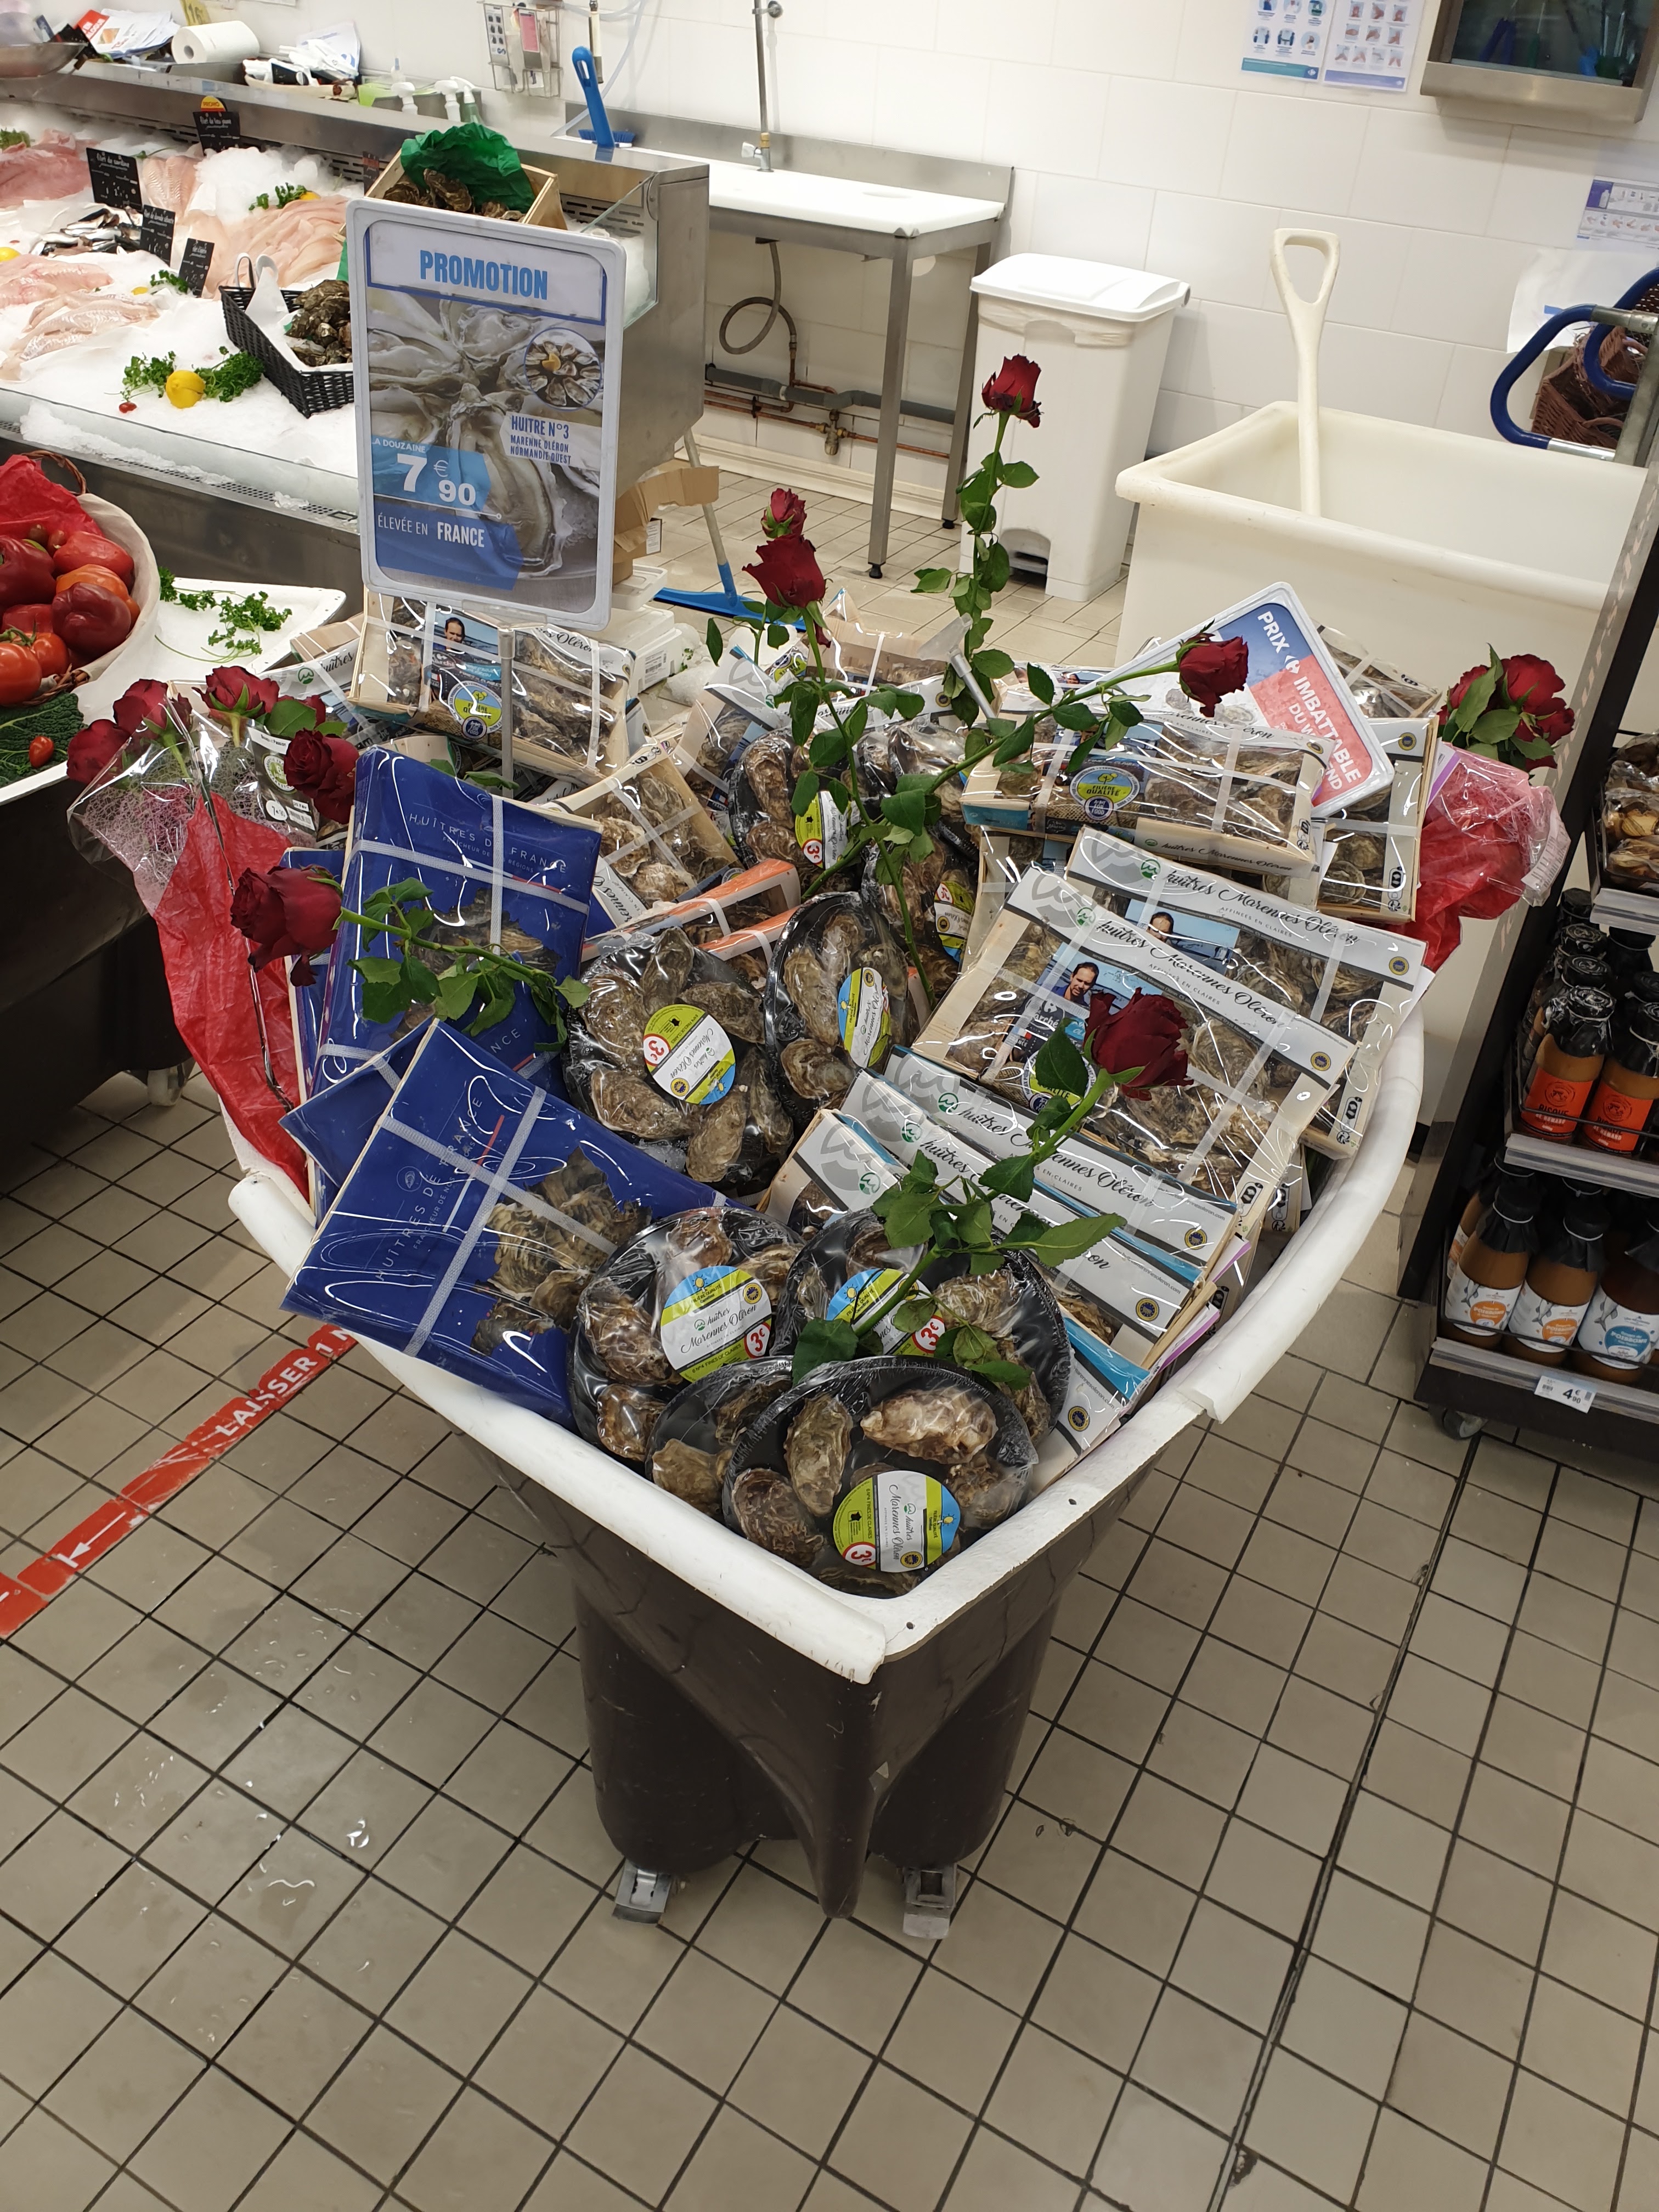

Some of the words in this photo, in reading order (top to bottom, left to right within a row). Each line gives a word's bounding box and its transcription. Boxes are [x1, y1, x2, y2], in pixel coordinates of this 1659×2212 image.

[420, 250, 548, 300] PROMOTION
[511, 415, 545, 436] HUITRE
[549, 422, 569, 439] N°3
[383, 439, 426, 454] DOUZAINE
[510, 446, 549, 461] NORMANDIE
[551, 453, 571, 465] OUEST
[511, 435, 541, 449] MARENNE
[544, 440, 569, 453] OLÉRON
[397, 453, 427, 493] 7
[439, 479, 476, 506] 90
[378, 512, 412, 533] ÉLEVÉE
[416, 522, 428, 535] EN
[437, 522, 485, 548] FRANCE
[557, 632, 591, 652] Oléro
[1257, 611, 1290, 654] PRIX
[1288, 703, 1306, 725] DU
[1293, 676, 1362, 783] IMBATTABLE
[409, 813, 475, 841] HUÎTRES
[1198, 848, 1254, 864] Marennes
[1256, 860, 1293, 871] Oléron
[1166, 870, 1216, 895] huîtres
[1218, 889, 1302, 924] Marennes
[1266, 924, 1293, 937] CLAIRES
[1096, 921, 1149, 948] huîtres
[1150, 946, 1234, 995] Marennes
[1193, 990, 1221, 1006] CLAIRES
[1032, 1013, 1059, 1029] arché
[489, 1028, 521, 1053] NCE
[648, 1040, 664, 1061] 3€
[688, 1028, 714, 1058] Marennes
[920, 1139, 970, 1173] huîtres
[958, 1107, 1007, 1136] huîtres
[1097, 1171, 1155, 1207] Oléron
[1053, 1174, 1082, 1192] CLAIRES
[375, 1205, 426, 1281] HUÎTRES
[681, 1321, 729, 1353] Marennes
[729, 1305, 757, 1326] Oléron
[707, 1308, 731, 1326] huîtres
[751, 1328, 765, 1352] 3€
[921, 1322, 939, 1346] 3€
[705, 1357, 718, 1367] FINES
[725, 1344, 742, 1357] CLAIRES
[215, 1357, 318, 1436] LAISSER
[1562, 1389, 1573, 1400] 4
[889, 1484, 902, 1537] Marennes
[905, 1515, 915, 1541] huîtres
[850, 1550, 872, 1562] 3€
[891, 1536, 904, 1560] Oléron
